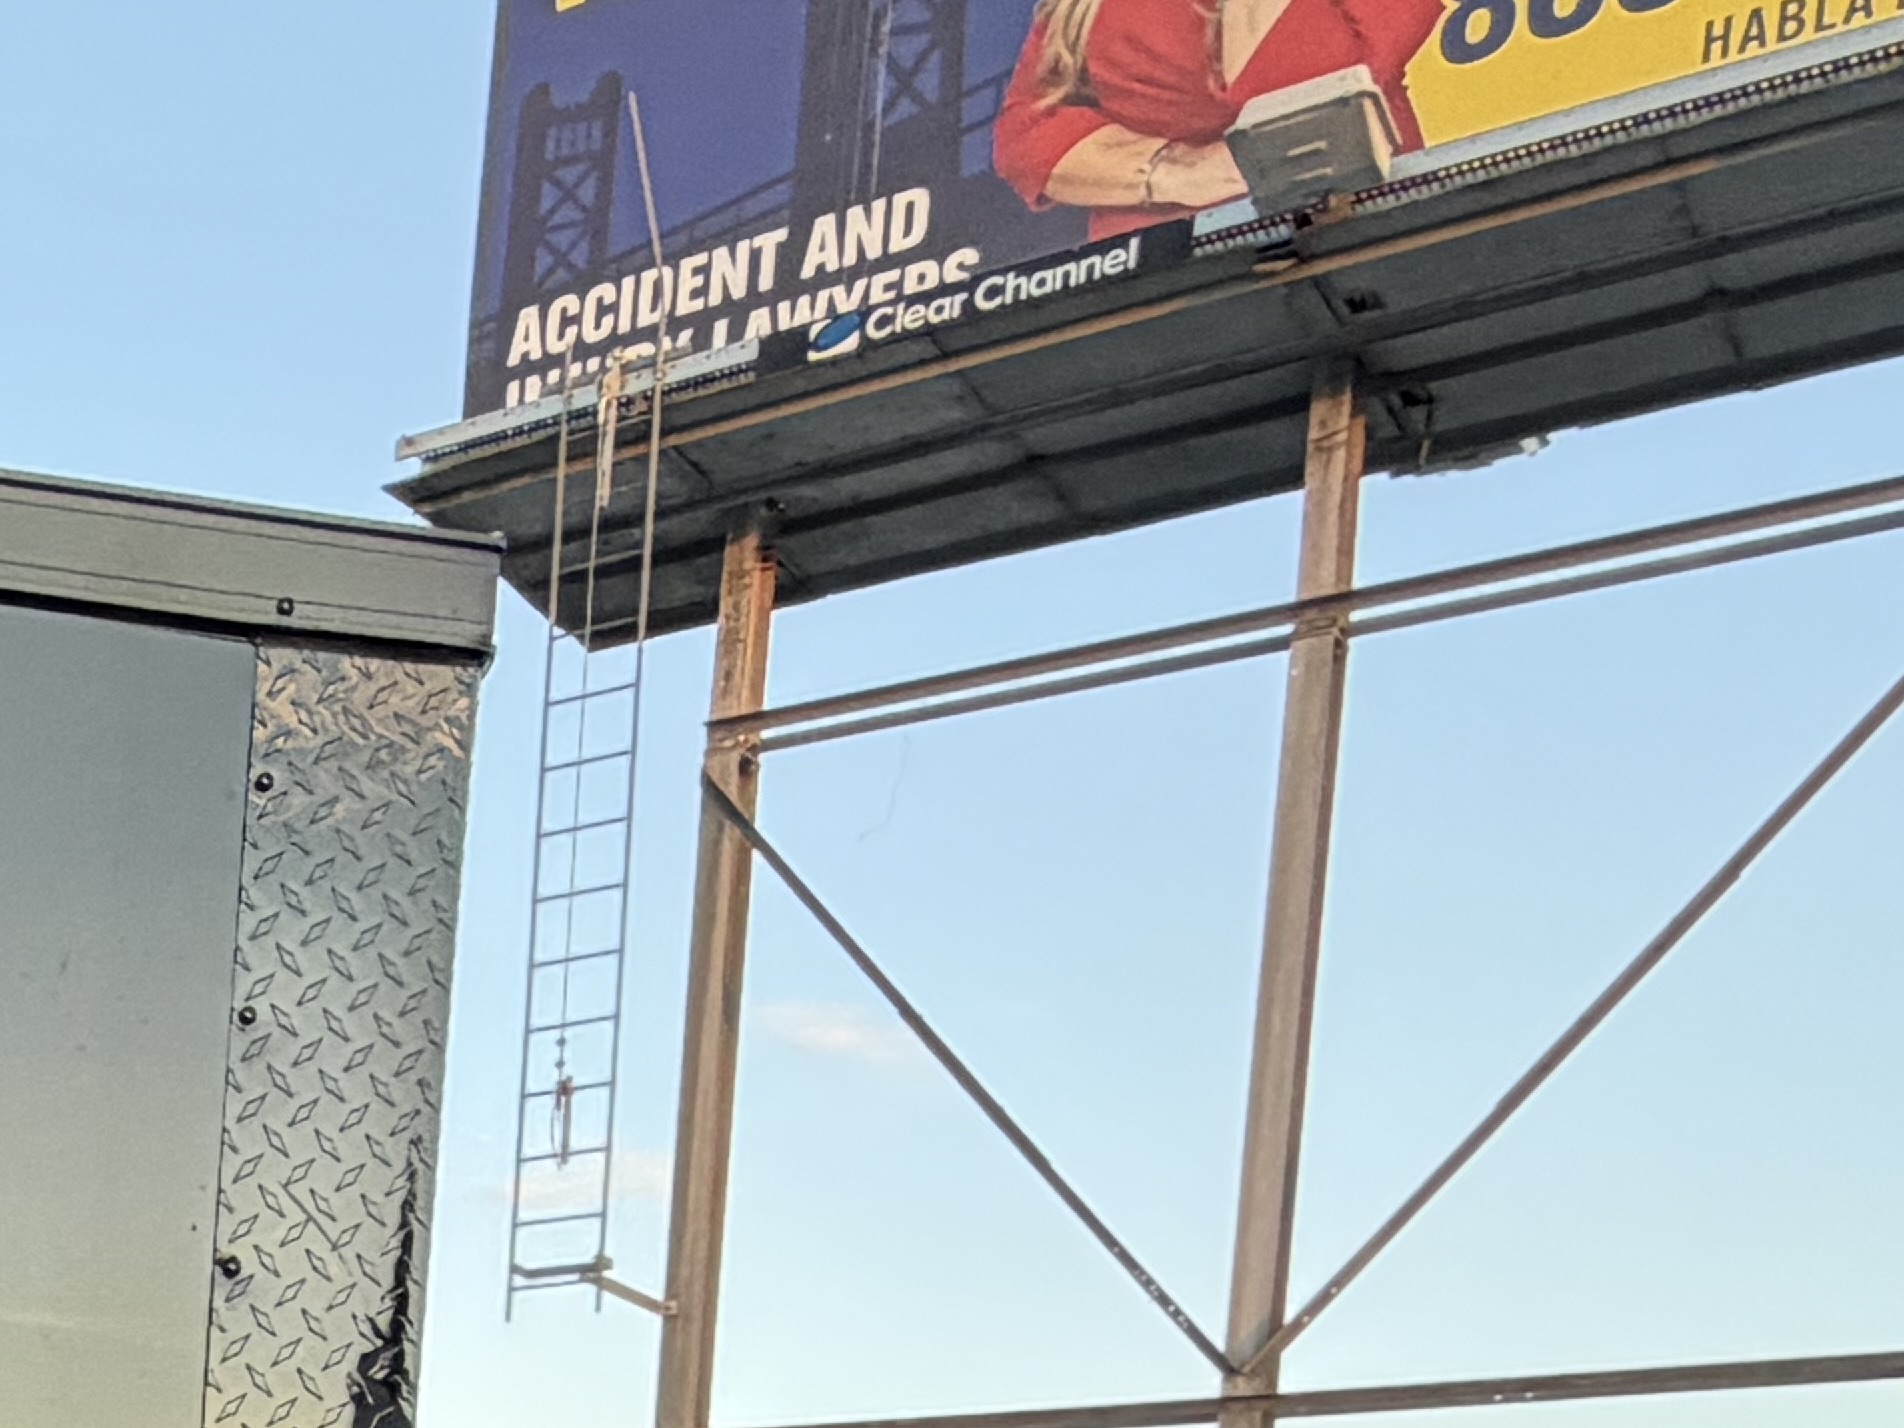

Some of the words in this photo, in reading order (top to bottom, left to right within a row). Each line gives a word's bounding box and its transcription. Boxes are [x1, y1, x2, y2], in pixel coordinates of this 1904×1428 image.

[1701, 0, 1874, 64] HABLA
[506, 225, 790, 368] ACCIDENT
[799, 186, 930, 280] AND
[864, 293, 969, 341] Clear
[973, 236, 1141, 312] Channel
